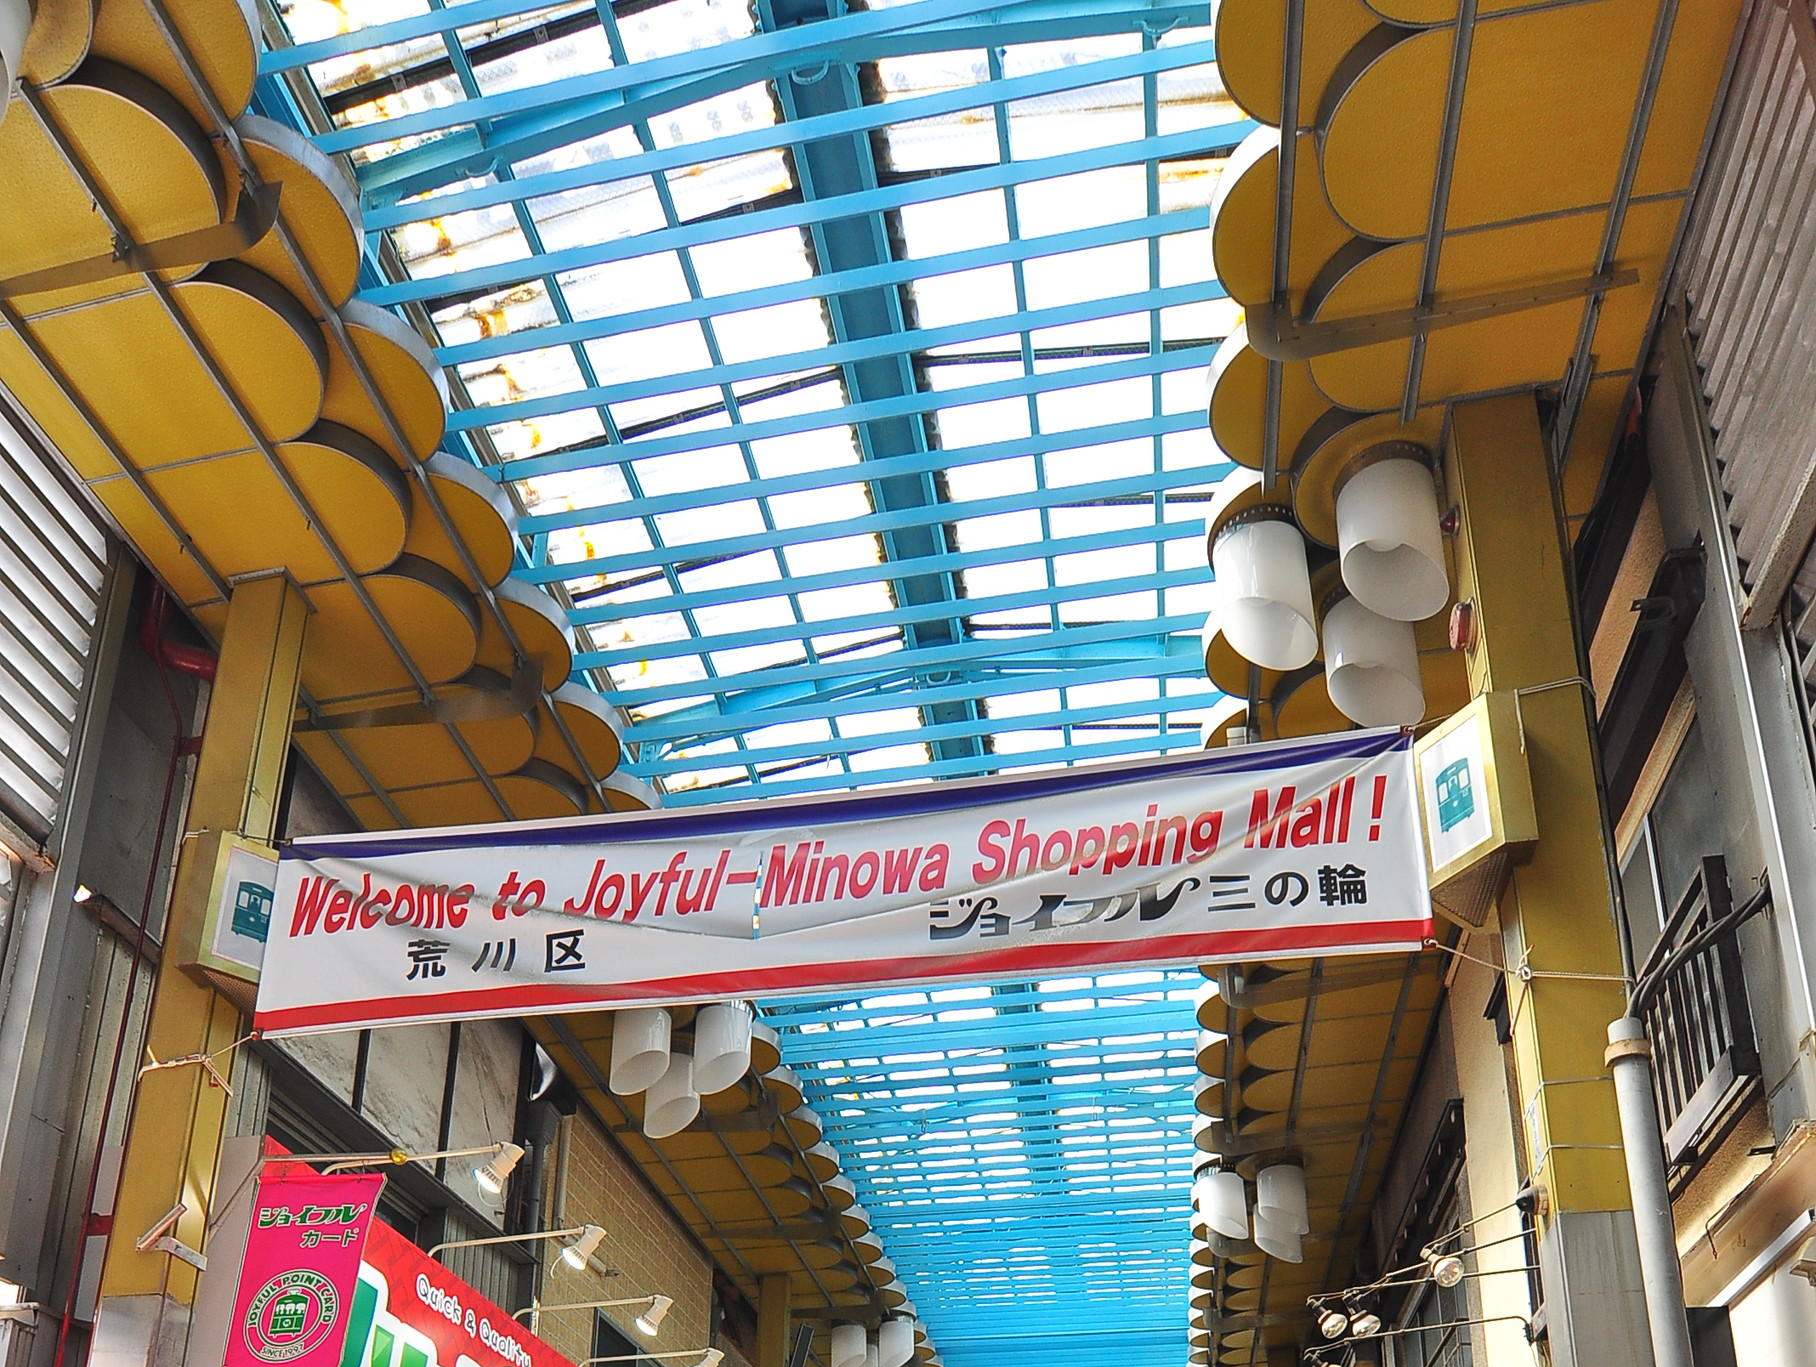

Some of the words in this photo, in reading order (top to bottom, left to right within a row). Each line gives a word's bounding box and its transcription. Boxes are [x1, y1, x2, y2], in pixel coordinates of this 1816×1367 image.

[288, 872, 476, 938] Welcome
[491, 870, 546, 922] to
[970, 803, 1223, 883] Shopping
[405, 928, 586, 982] 荒川区
[258, 1203, 368, 1229] ジョイフル
[300, 1228, 360, 1248] カード
[248, 1285, 280, 1327] JOYFUL
[282, 1273, 322, 1290] POINT
[320, 1286, 337, 1324] CARD
[416, 1273, 463, 1324] Quick
[465, 1311, 479, 1335] &
